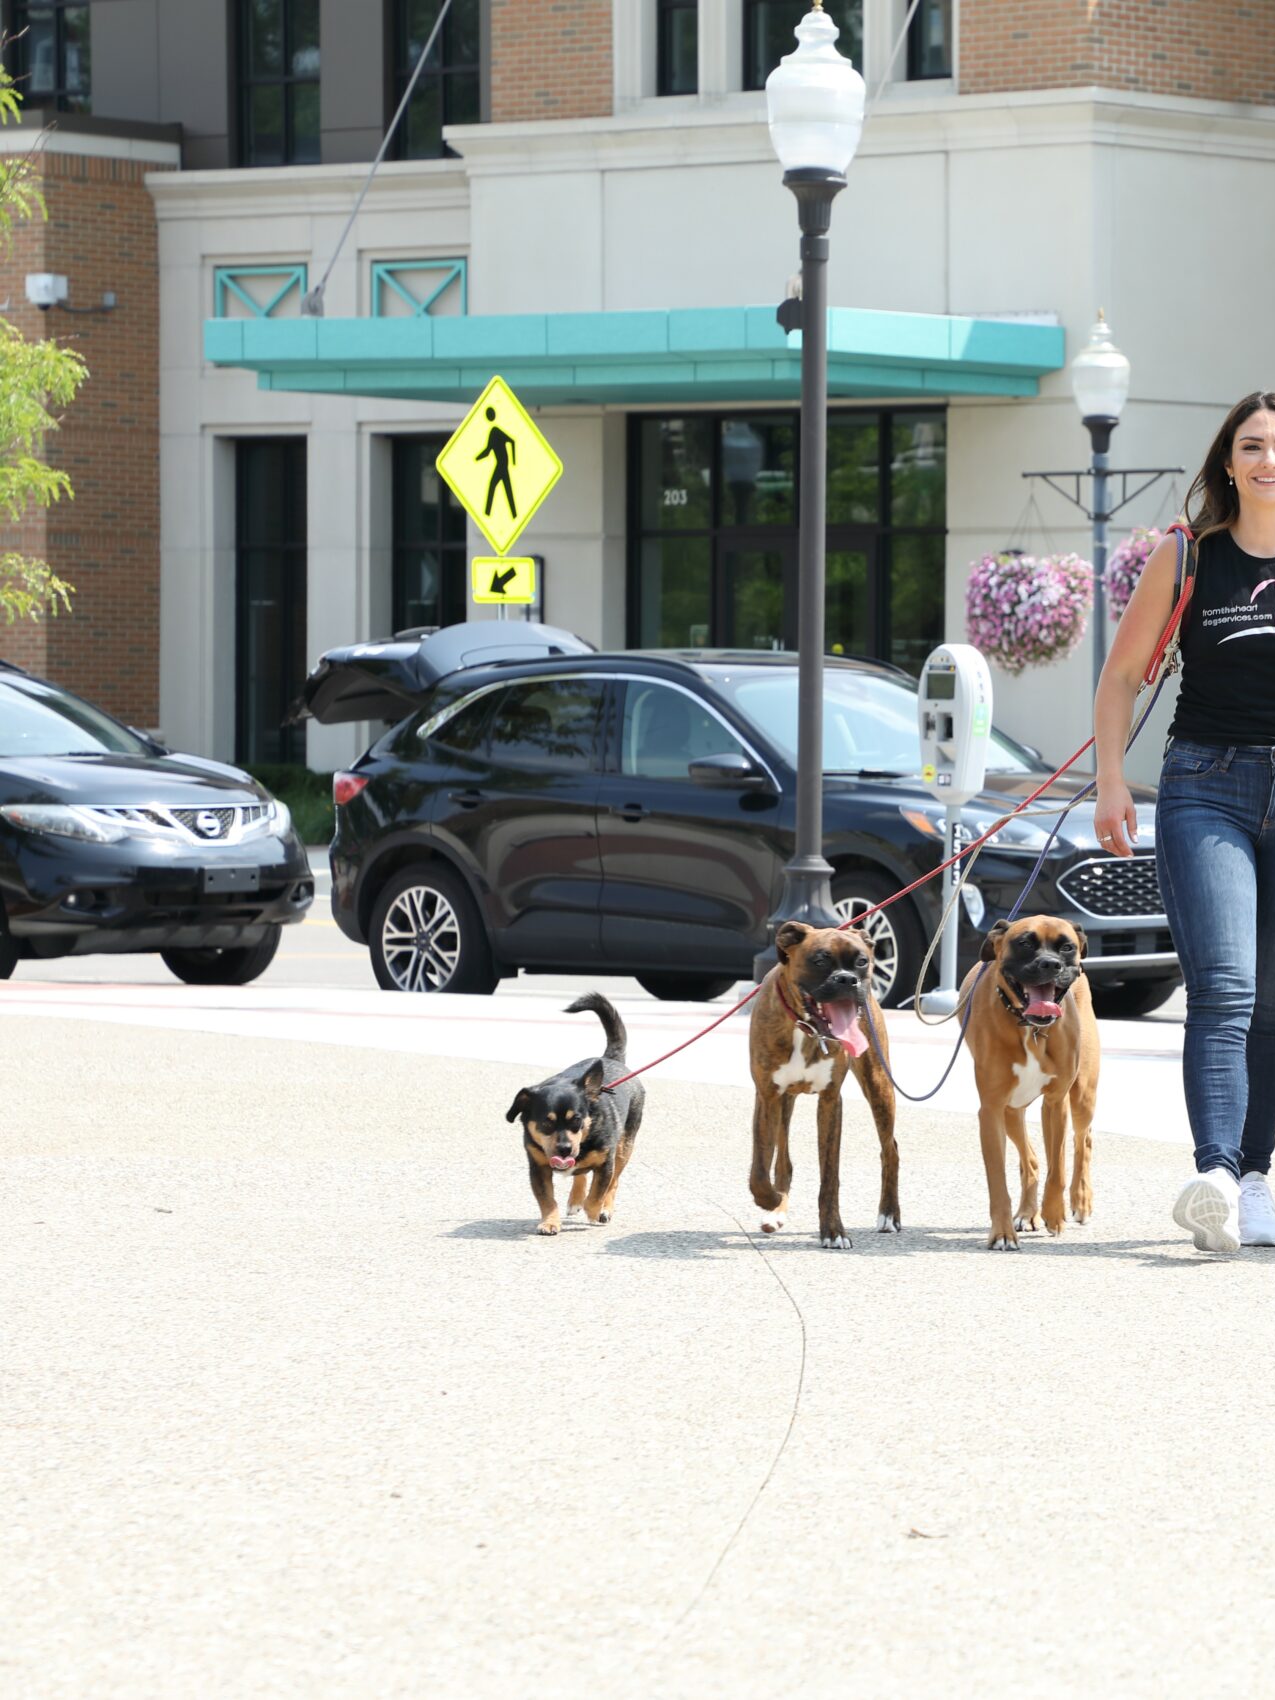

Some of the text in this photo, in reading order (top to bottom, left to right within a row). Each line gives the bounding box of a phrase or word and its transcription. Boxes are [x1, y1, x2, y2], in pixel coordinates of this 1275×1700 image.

[664, 490, 687, 506] 203
[1202, 603, 1258, 617] fromtheheart
[1202, 613, 1272, 625] dogservices.com
